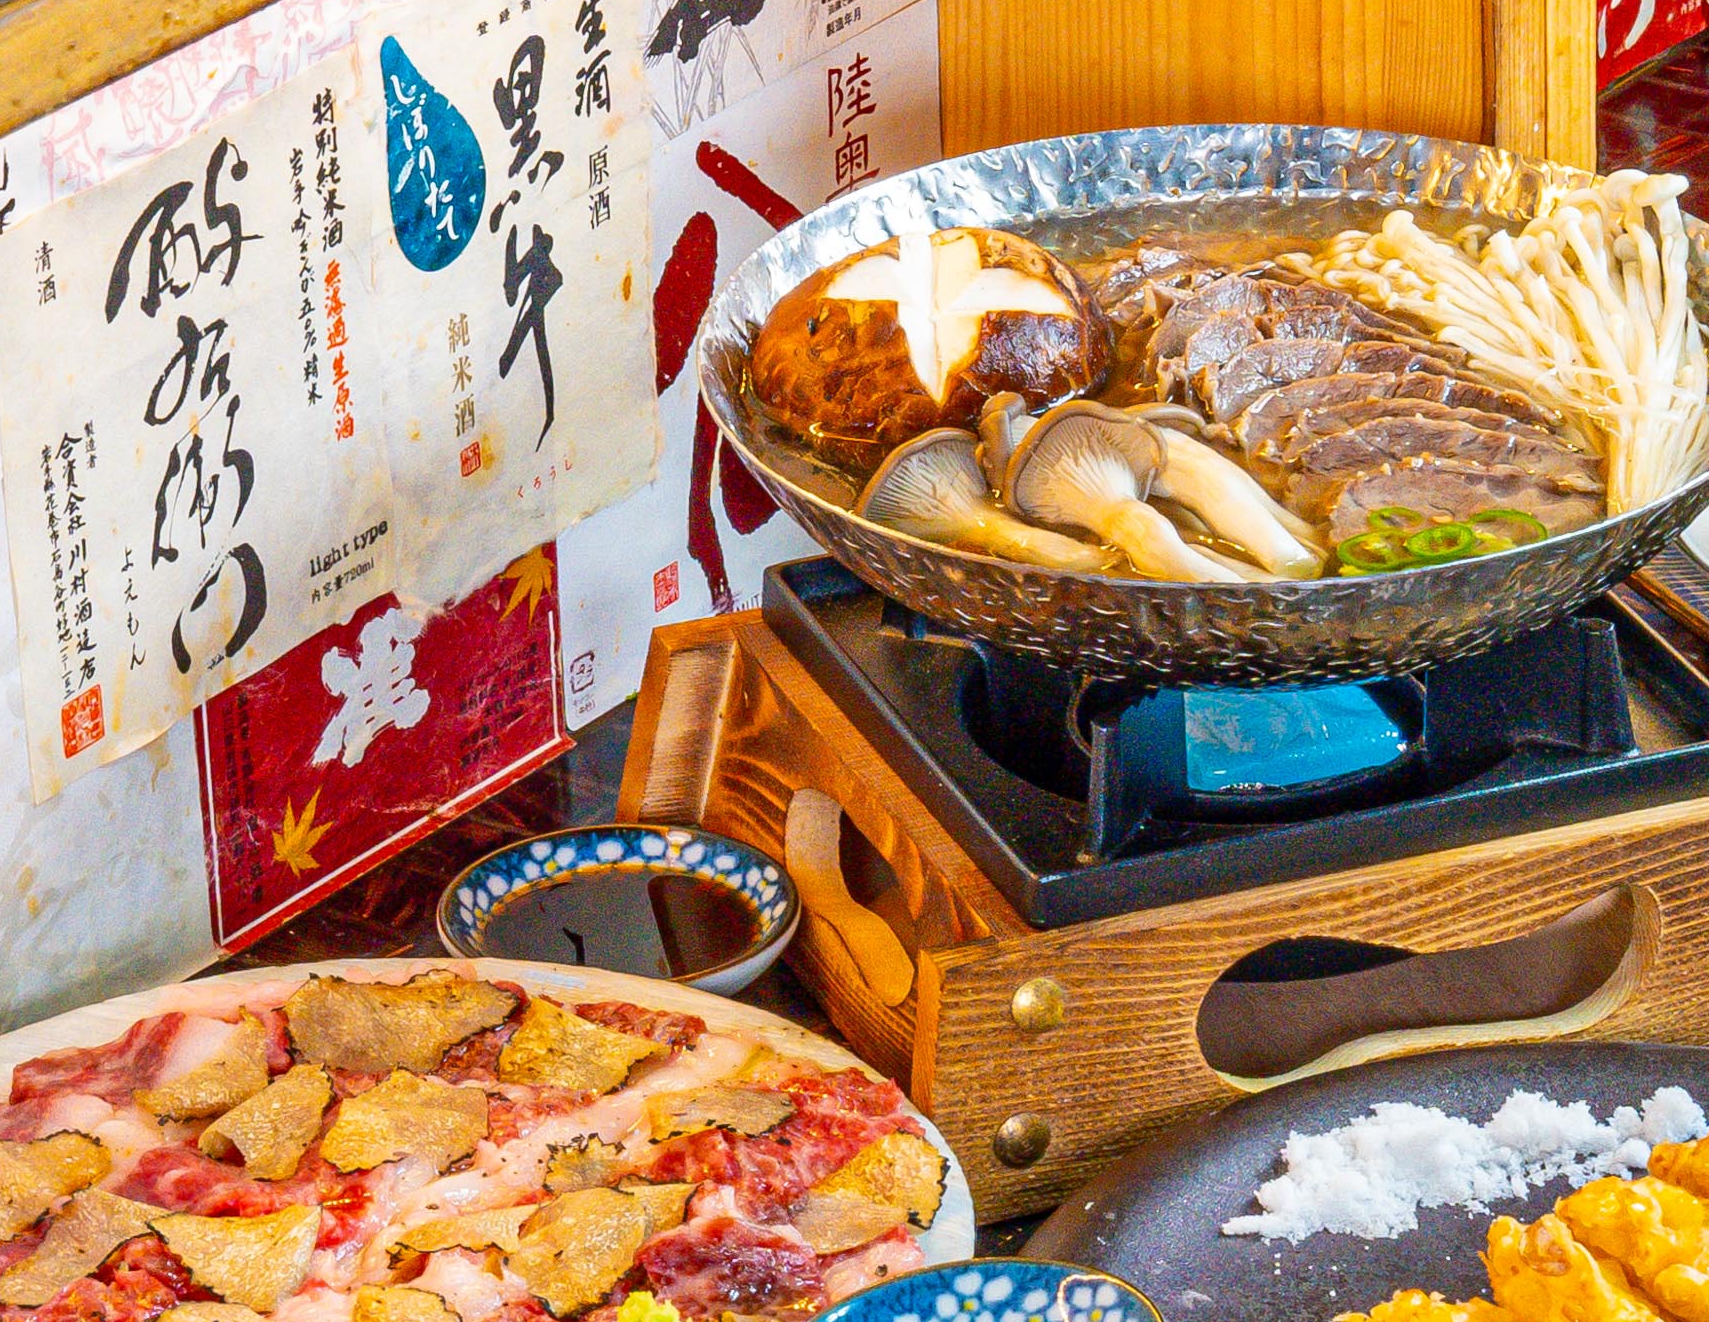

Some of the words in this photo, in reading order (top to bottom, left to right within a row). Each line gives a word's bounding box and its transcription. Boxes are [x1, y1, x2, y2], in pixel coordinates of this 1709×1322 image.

[312, 87, 345, 254] 特別純米酒
[586, 144, 611, 230] 原酒
[34, 238, 58, 309] 清酒
[445, 311, 476, 440] 純米酒
[309, 542, 350, 578] light
[352, 520, 389, 552] type
[120, 545, 146, 672] よえもん
